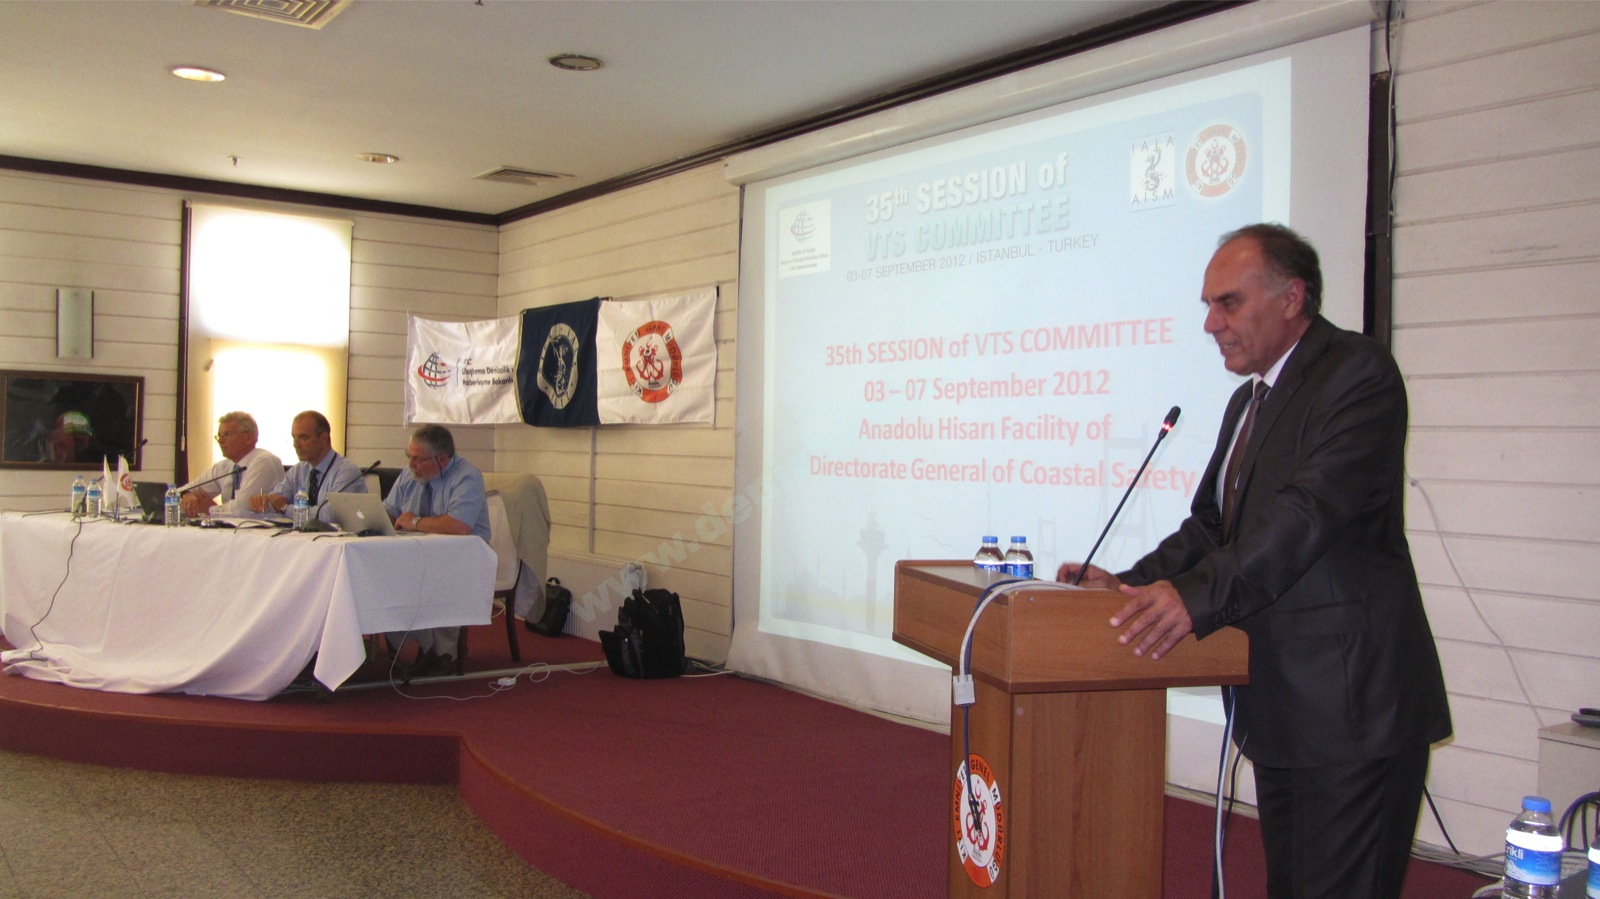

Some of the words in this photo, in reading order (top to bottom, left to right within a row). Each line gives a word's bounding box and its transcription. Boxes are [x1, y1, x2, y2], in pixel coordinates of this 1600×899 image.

[1131, 135, 1174, 154] IALA
[866, 187, 908, 224] 35th
[916, 161, 1027, 214] SESSION
[1038, 151, 1070, 190] of
[1131, 188, 1174, 205] AISM
[867, 227, 907, 262] VTS
[914, 196, 1071, 254] COMMITTEE
[846, 267, 872, 282] 03-07
[875, 258, 936, 278] SEPTEMBER
[939, 254, 965, 270] 2012
[976, 243, 1035, 264] ISTANBUL
[1047, 233, 1100, 253] TURKEY
[825, 342, 862, 367] 35th
[866, 336, 944, 365] SESSION
[948, 333, 970, 359] of
[974, 330, 1015, 357] VTS
[1019, 317, 1174, 353] COMMITTEE
[863, 380, 886, 403] 03
[904, 379, 927, 401] 07
[932, 372, 1047, 405] September
[1052, 369, 1111, 396] 2012
[858, 416, 934, 442] Anadolu
[1001, 413, 1080, 447] Facility
[1085, 413, 1113, 441] of
[809, 455, 908, 480] Directorate
[910, 458, 988, 483] General
[991, 459, 1016, 484] of
[1019, 460, 1104, 488] Coastal
[1110, 461, 1196, 498] Safety
[970, 759, 991, 782] GENEL
[1506, 845, 1524, 859] rikli
